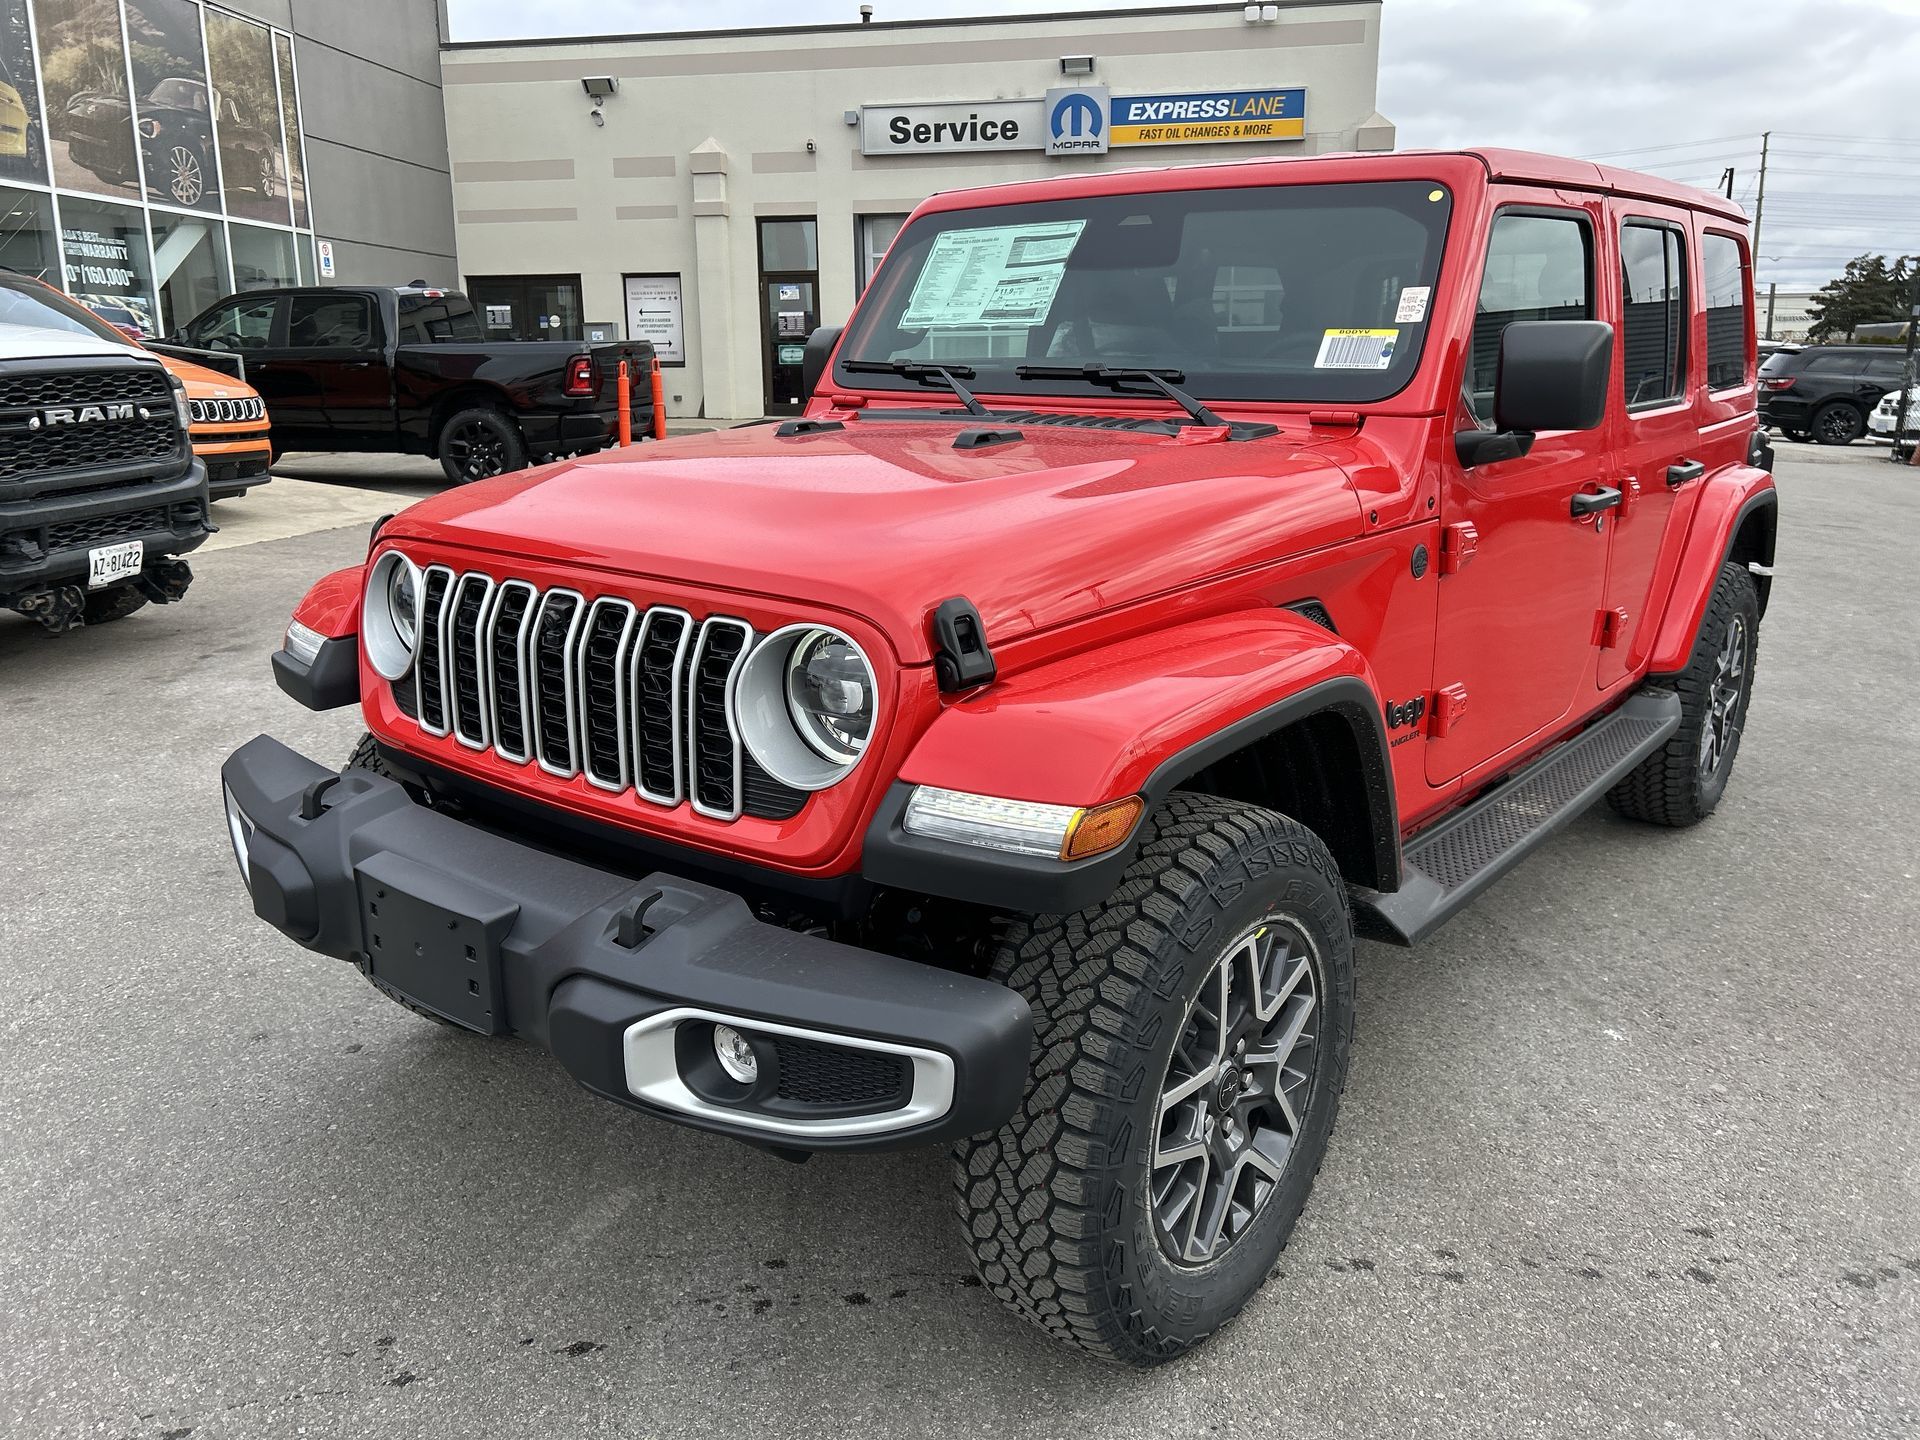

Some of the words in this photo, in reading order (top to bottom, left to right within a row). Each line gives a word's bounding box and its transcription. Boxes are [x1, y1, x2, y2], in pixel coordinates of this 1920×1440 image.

[889, 113, 1019, 145] Service
[1139, 128, 1163, 140] FAST
[1165, 127, 1181, 139] OIL
[1184, 125, 1230, 138] CHANGES
[1233, 125, 1240, 136] &
[1242, 123, 1273, 135] MORE
[1053, 141, 1100, 149] MOPAR
[81, 243, 129, 260] WARRANTY
[44, 404, 134, 426] RAM
[1386, 695, 1425, 730] Jeep
